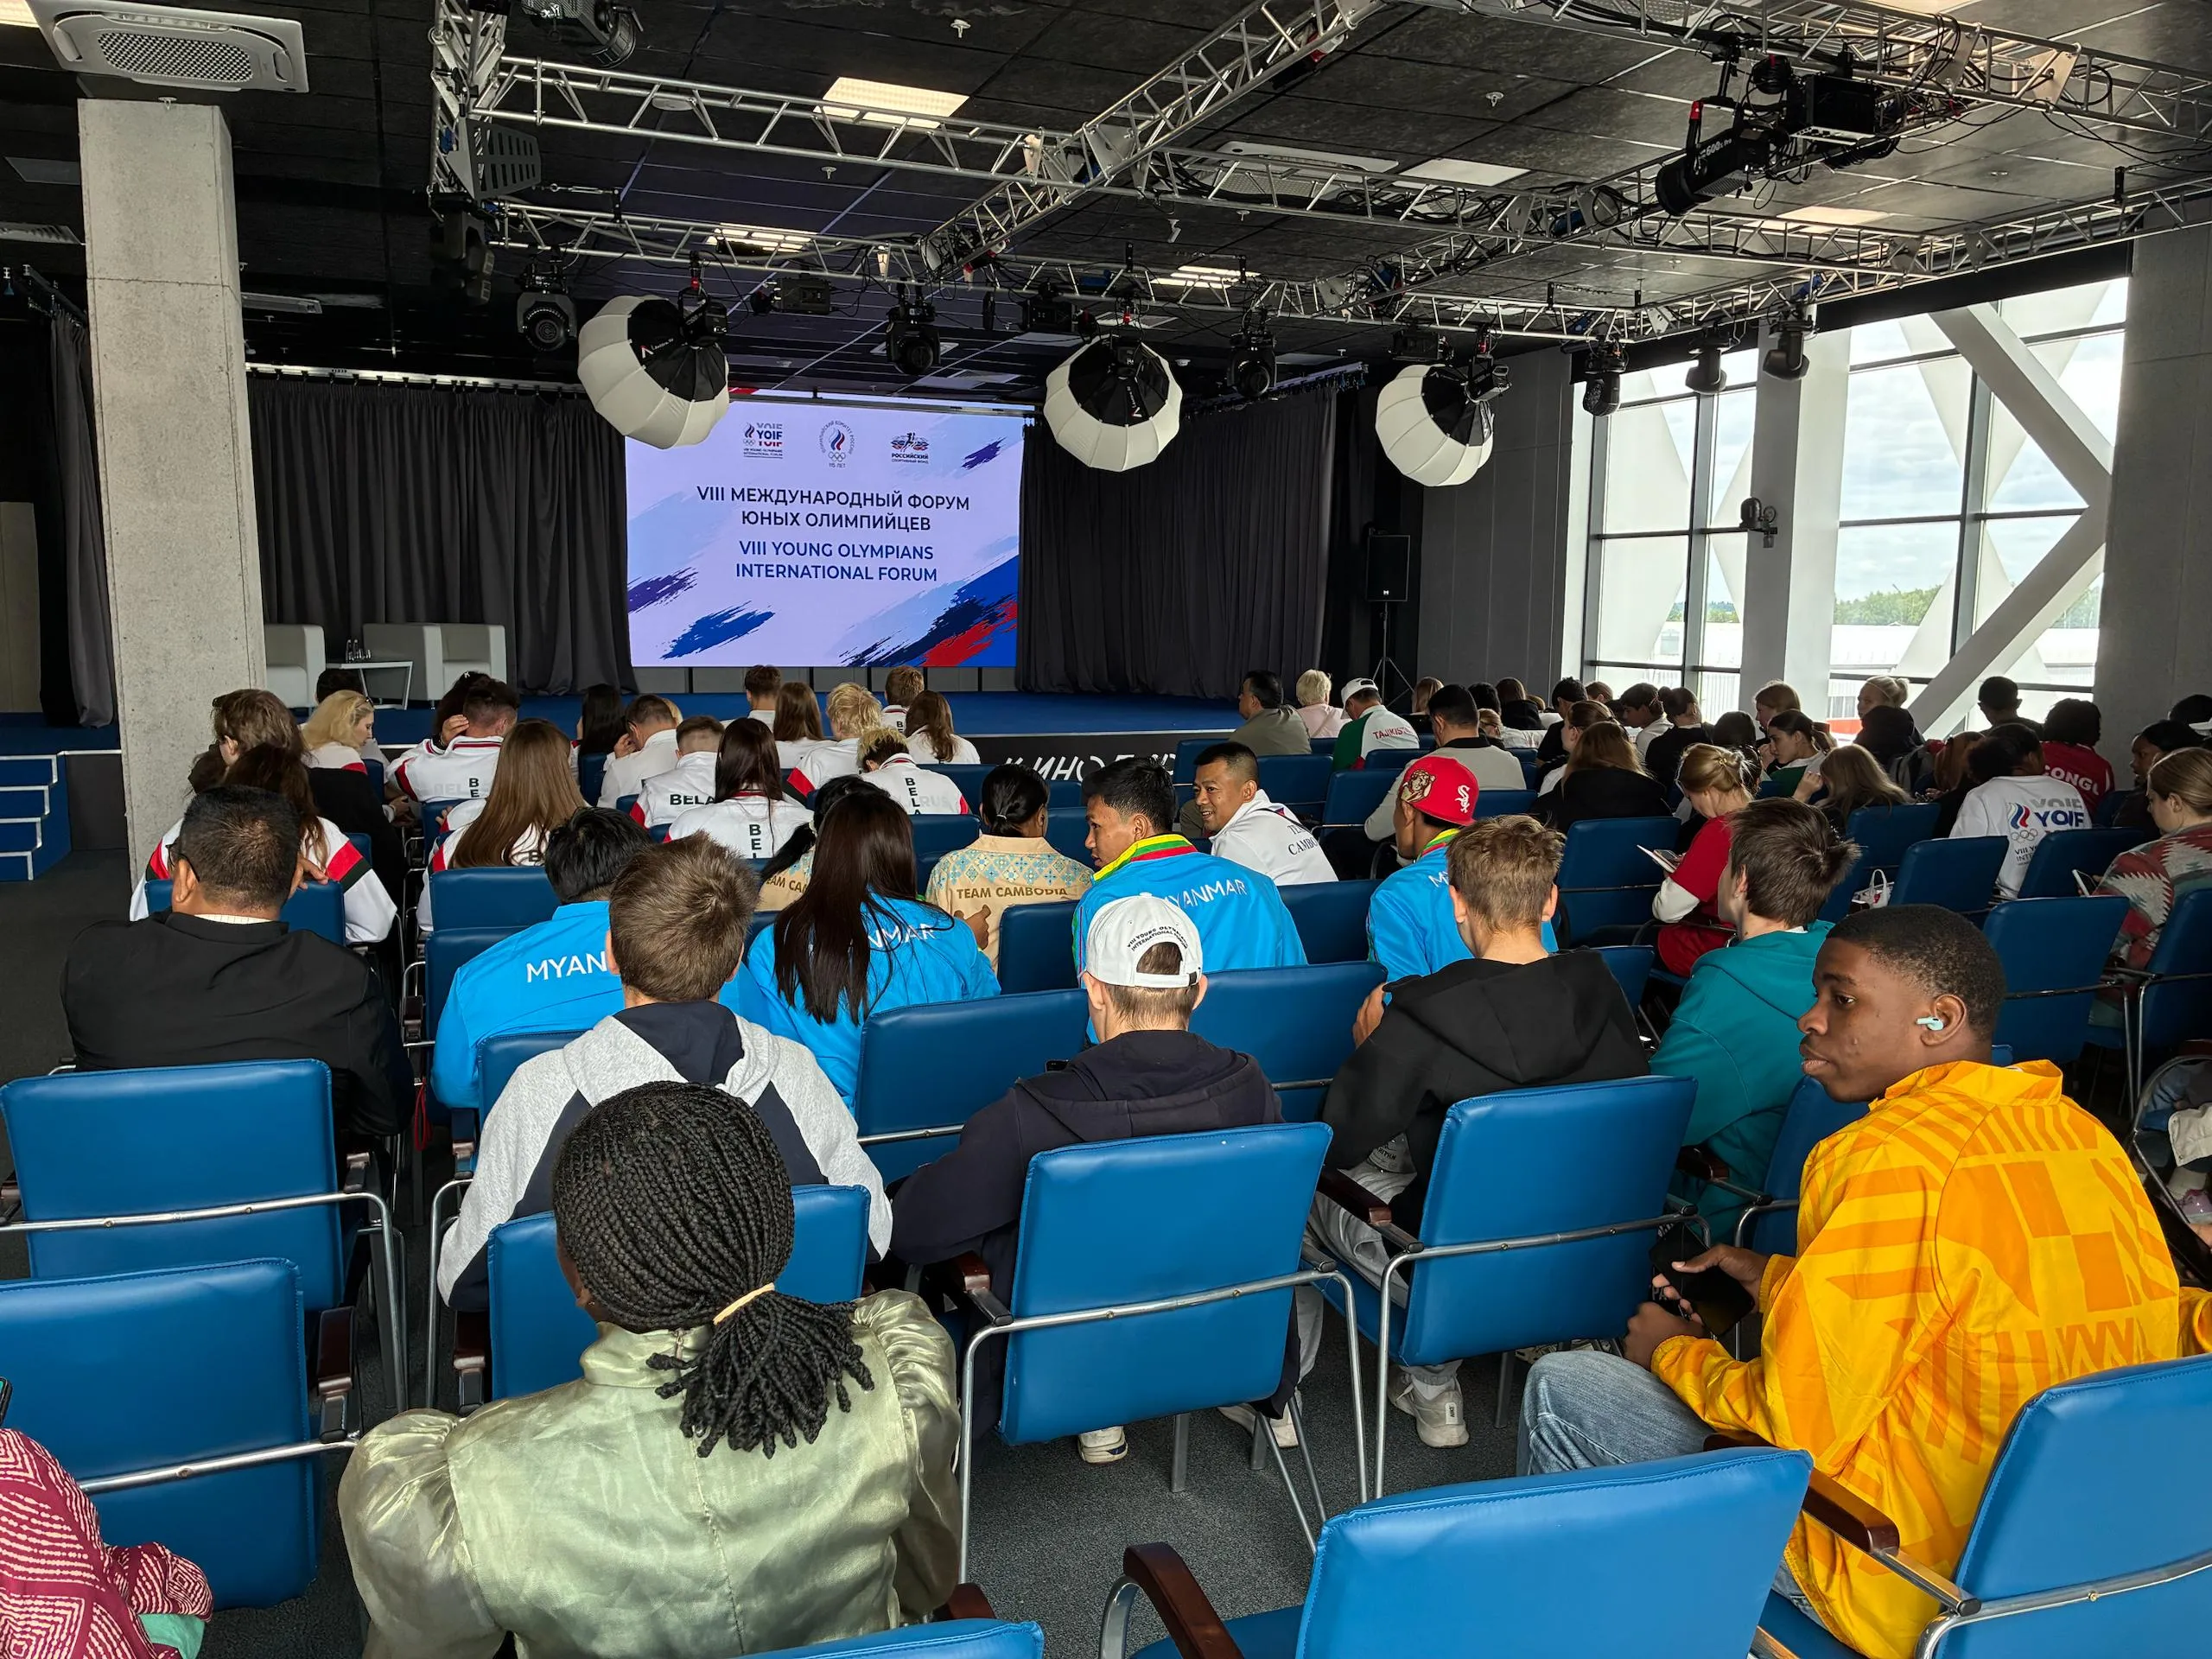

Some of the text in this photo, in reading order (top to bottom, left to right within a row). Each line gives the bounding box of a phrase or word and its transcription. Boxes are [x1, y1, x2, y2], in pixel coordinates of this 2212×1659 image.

[756, 430, 783, 440] YOIF
[696, 486, 969, 511] VIII МЕЖДУНАРОДНЫЙ ФОРУМ
[741, 511, 931, 532] ЮНЫХ ОЛИМПИЙЦЕВ
[739, 541, 934, 560] VIII YOUNG OLYMPIANS
[736, 563, 938, 582] INTERNATIONAL FORUM
[2034, 810, 2084, 827] YOIF
[957, 887, 1068, 899] TEAM CAMBODIA
[1135, 928, 1157, 939] YOUNG
[526, 950, 607, 983] MYAN
